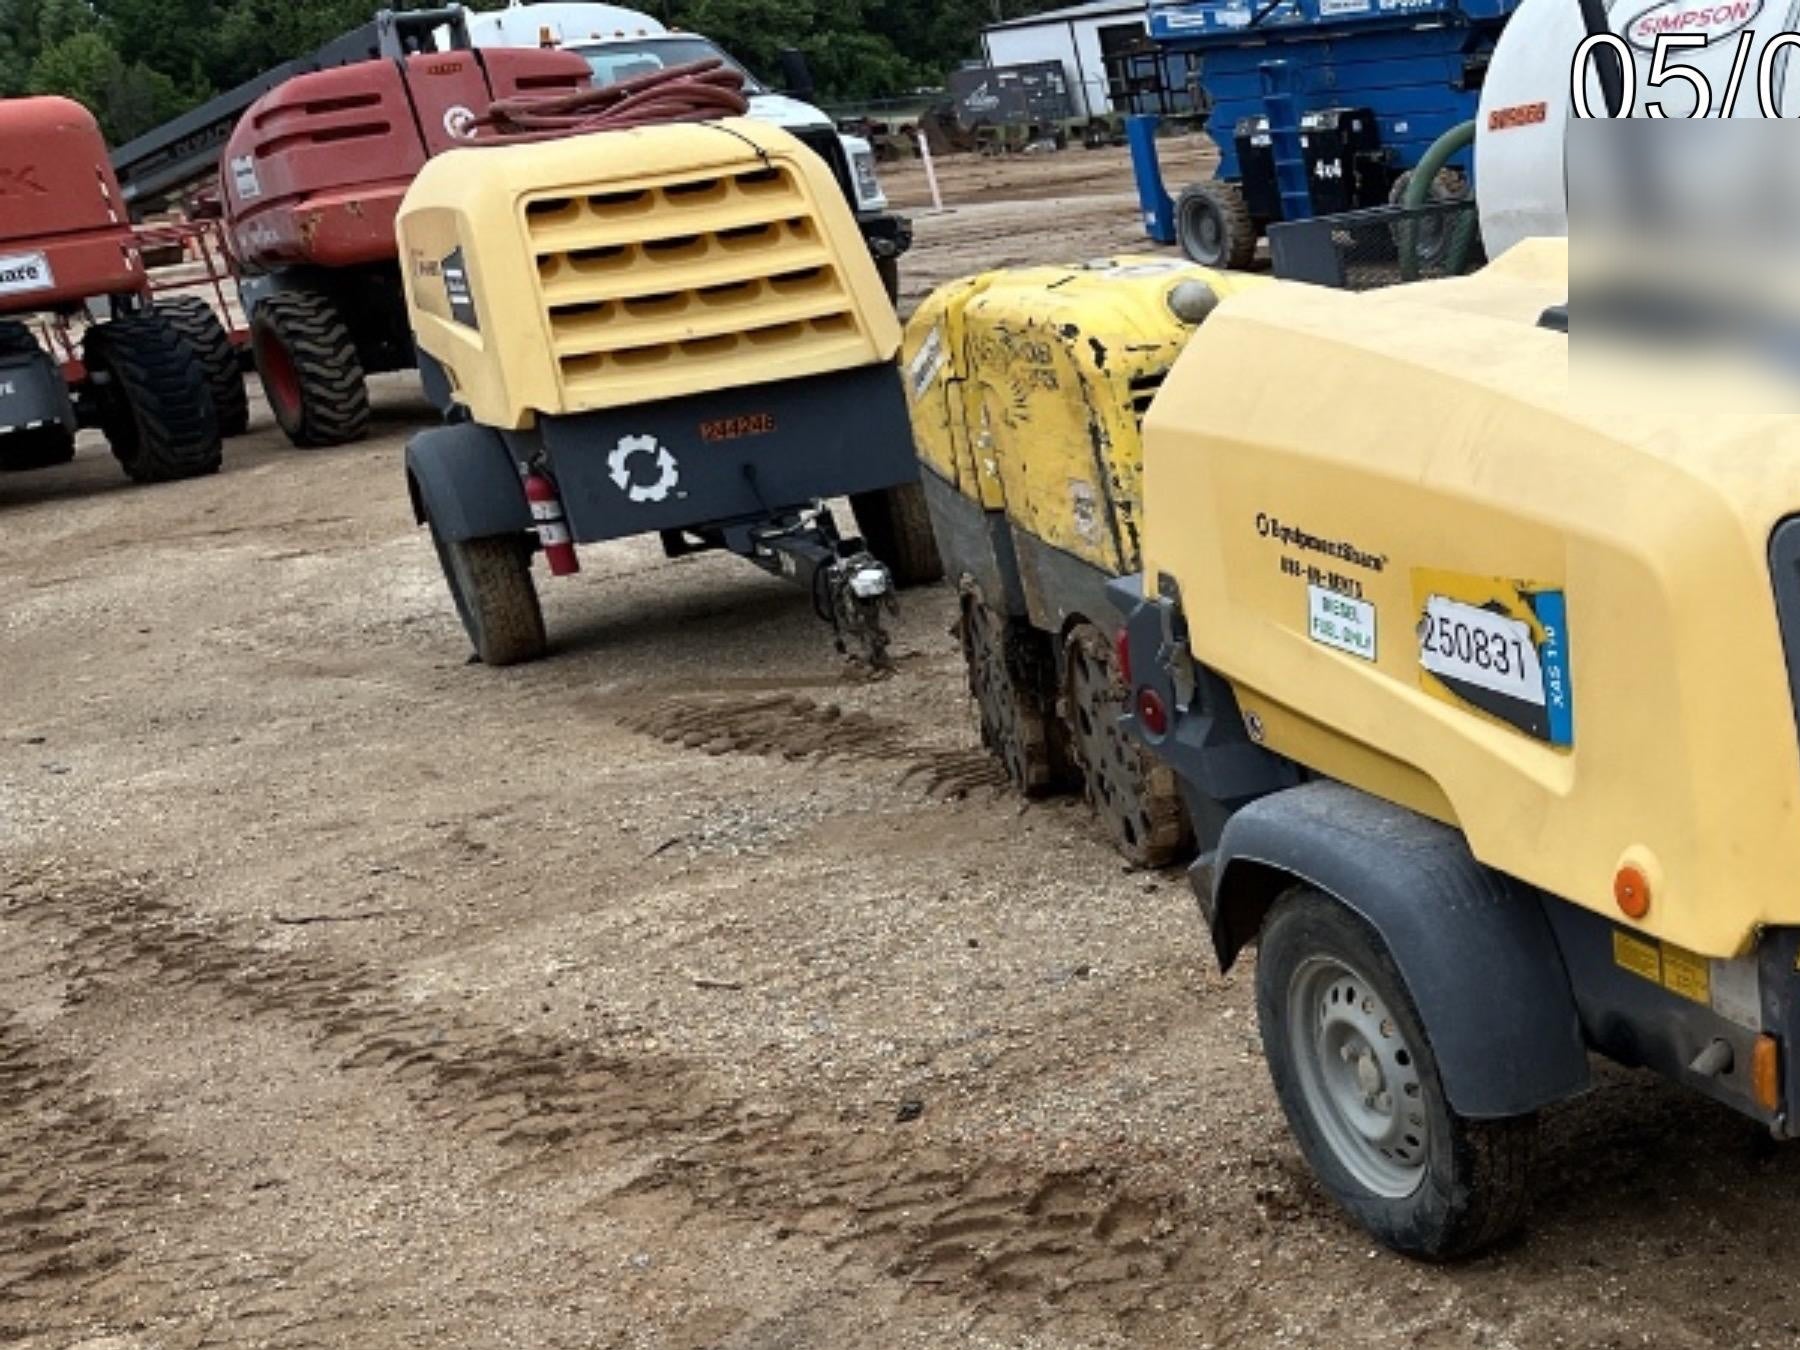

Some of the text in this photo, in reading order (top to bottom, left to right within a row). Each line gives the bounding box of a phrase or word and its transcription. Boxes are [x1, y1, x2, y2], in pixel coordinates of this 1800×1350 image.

[1637, 0, 1751, 36] SIMPSON
[1314, 158, 1342, 179] 4x4
[1423, 611, 1525, 681] 250831
